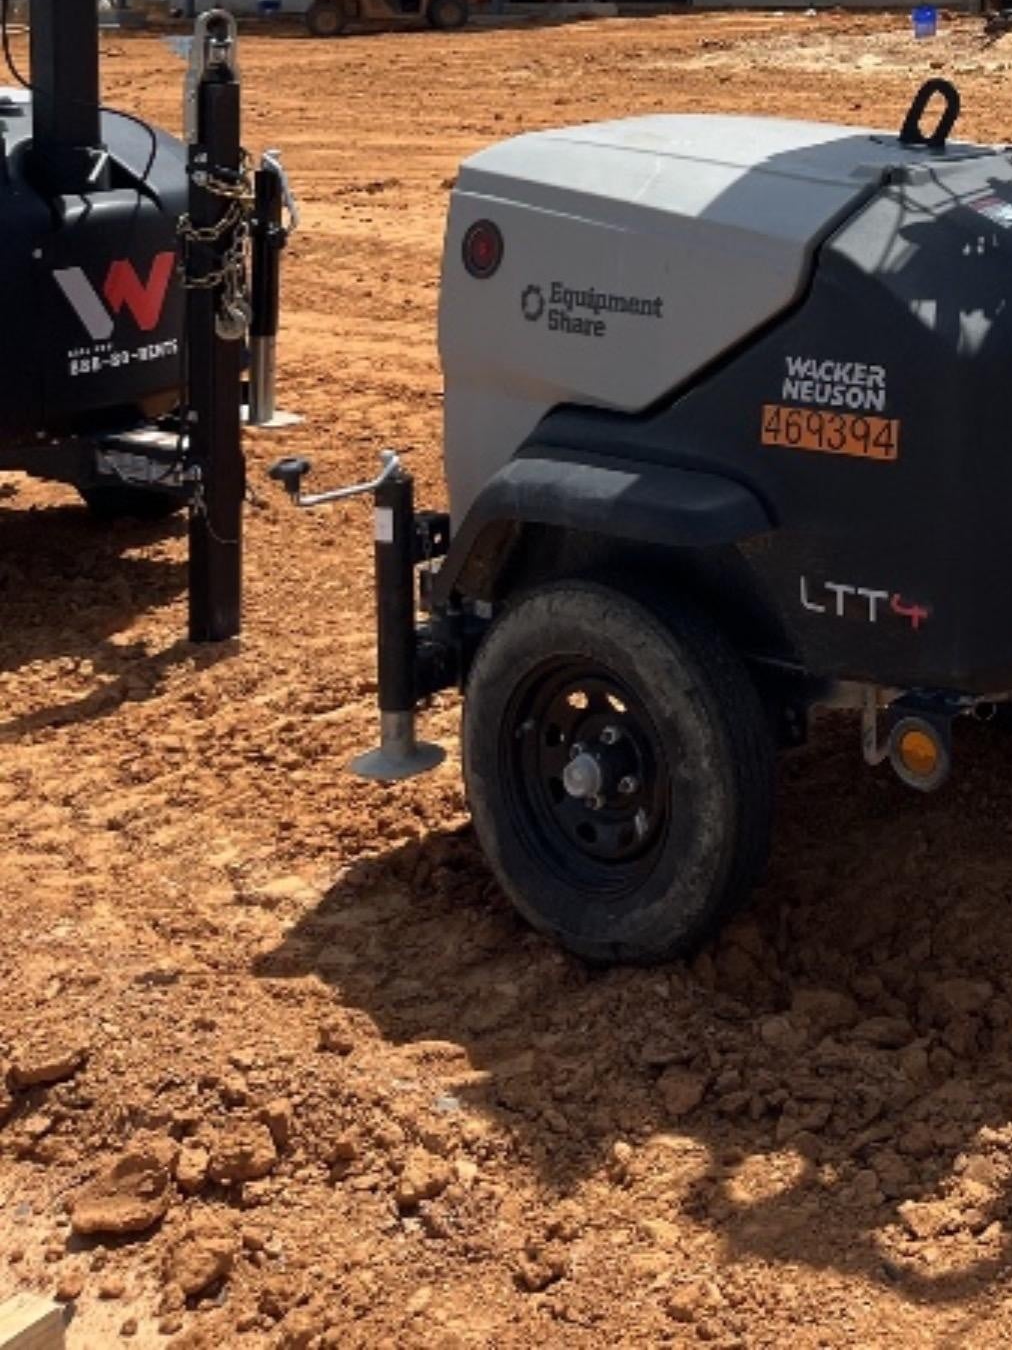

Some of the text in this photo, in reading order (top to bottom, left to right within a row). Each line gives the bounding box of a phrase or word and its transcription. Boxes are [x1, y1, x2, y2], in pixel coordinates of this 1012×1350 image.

[549, 282, 664, 318] Equipment
[548, 309, 606, 336] Share
[785, 356, 886, 387] WACKER
[782, 378, 886, 412] NEUSON
[764, 406, 895, 456] 469394
[800, 574, 929, 628] LTT4
